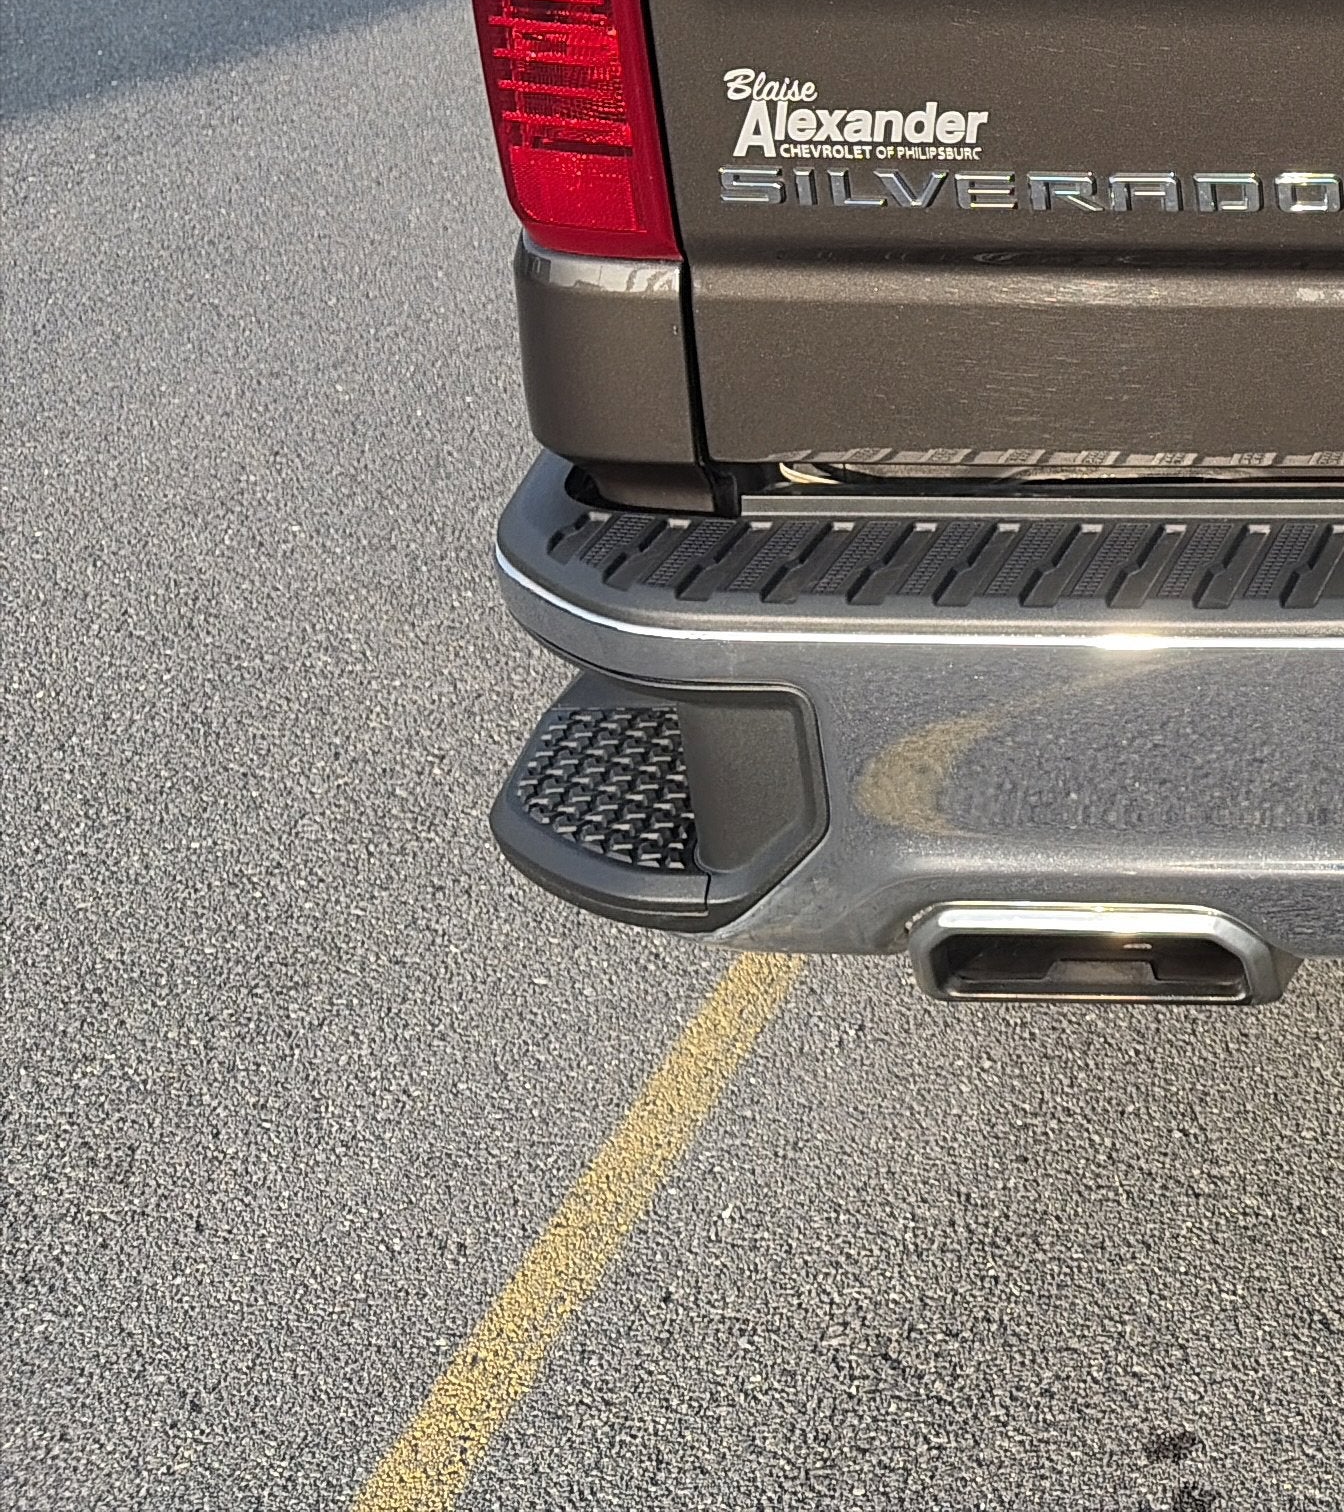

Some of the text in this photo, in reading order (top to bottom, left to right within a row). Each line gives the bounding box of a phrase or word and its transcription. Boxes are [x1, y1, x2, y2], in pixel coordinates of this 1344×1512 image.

[723, 68, 818, 102] Blaise
[733, 99, 989, 157] Alexander
[779, 143, 872, 160] CHEVROLET
[875, 144, 895, 159] OF
